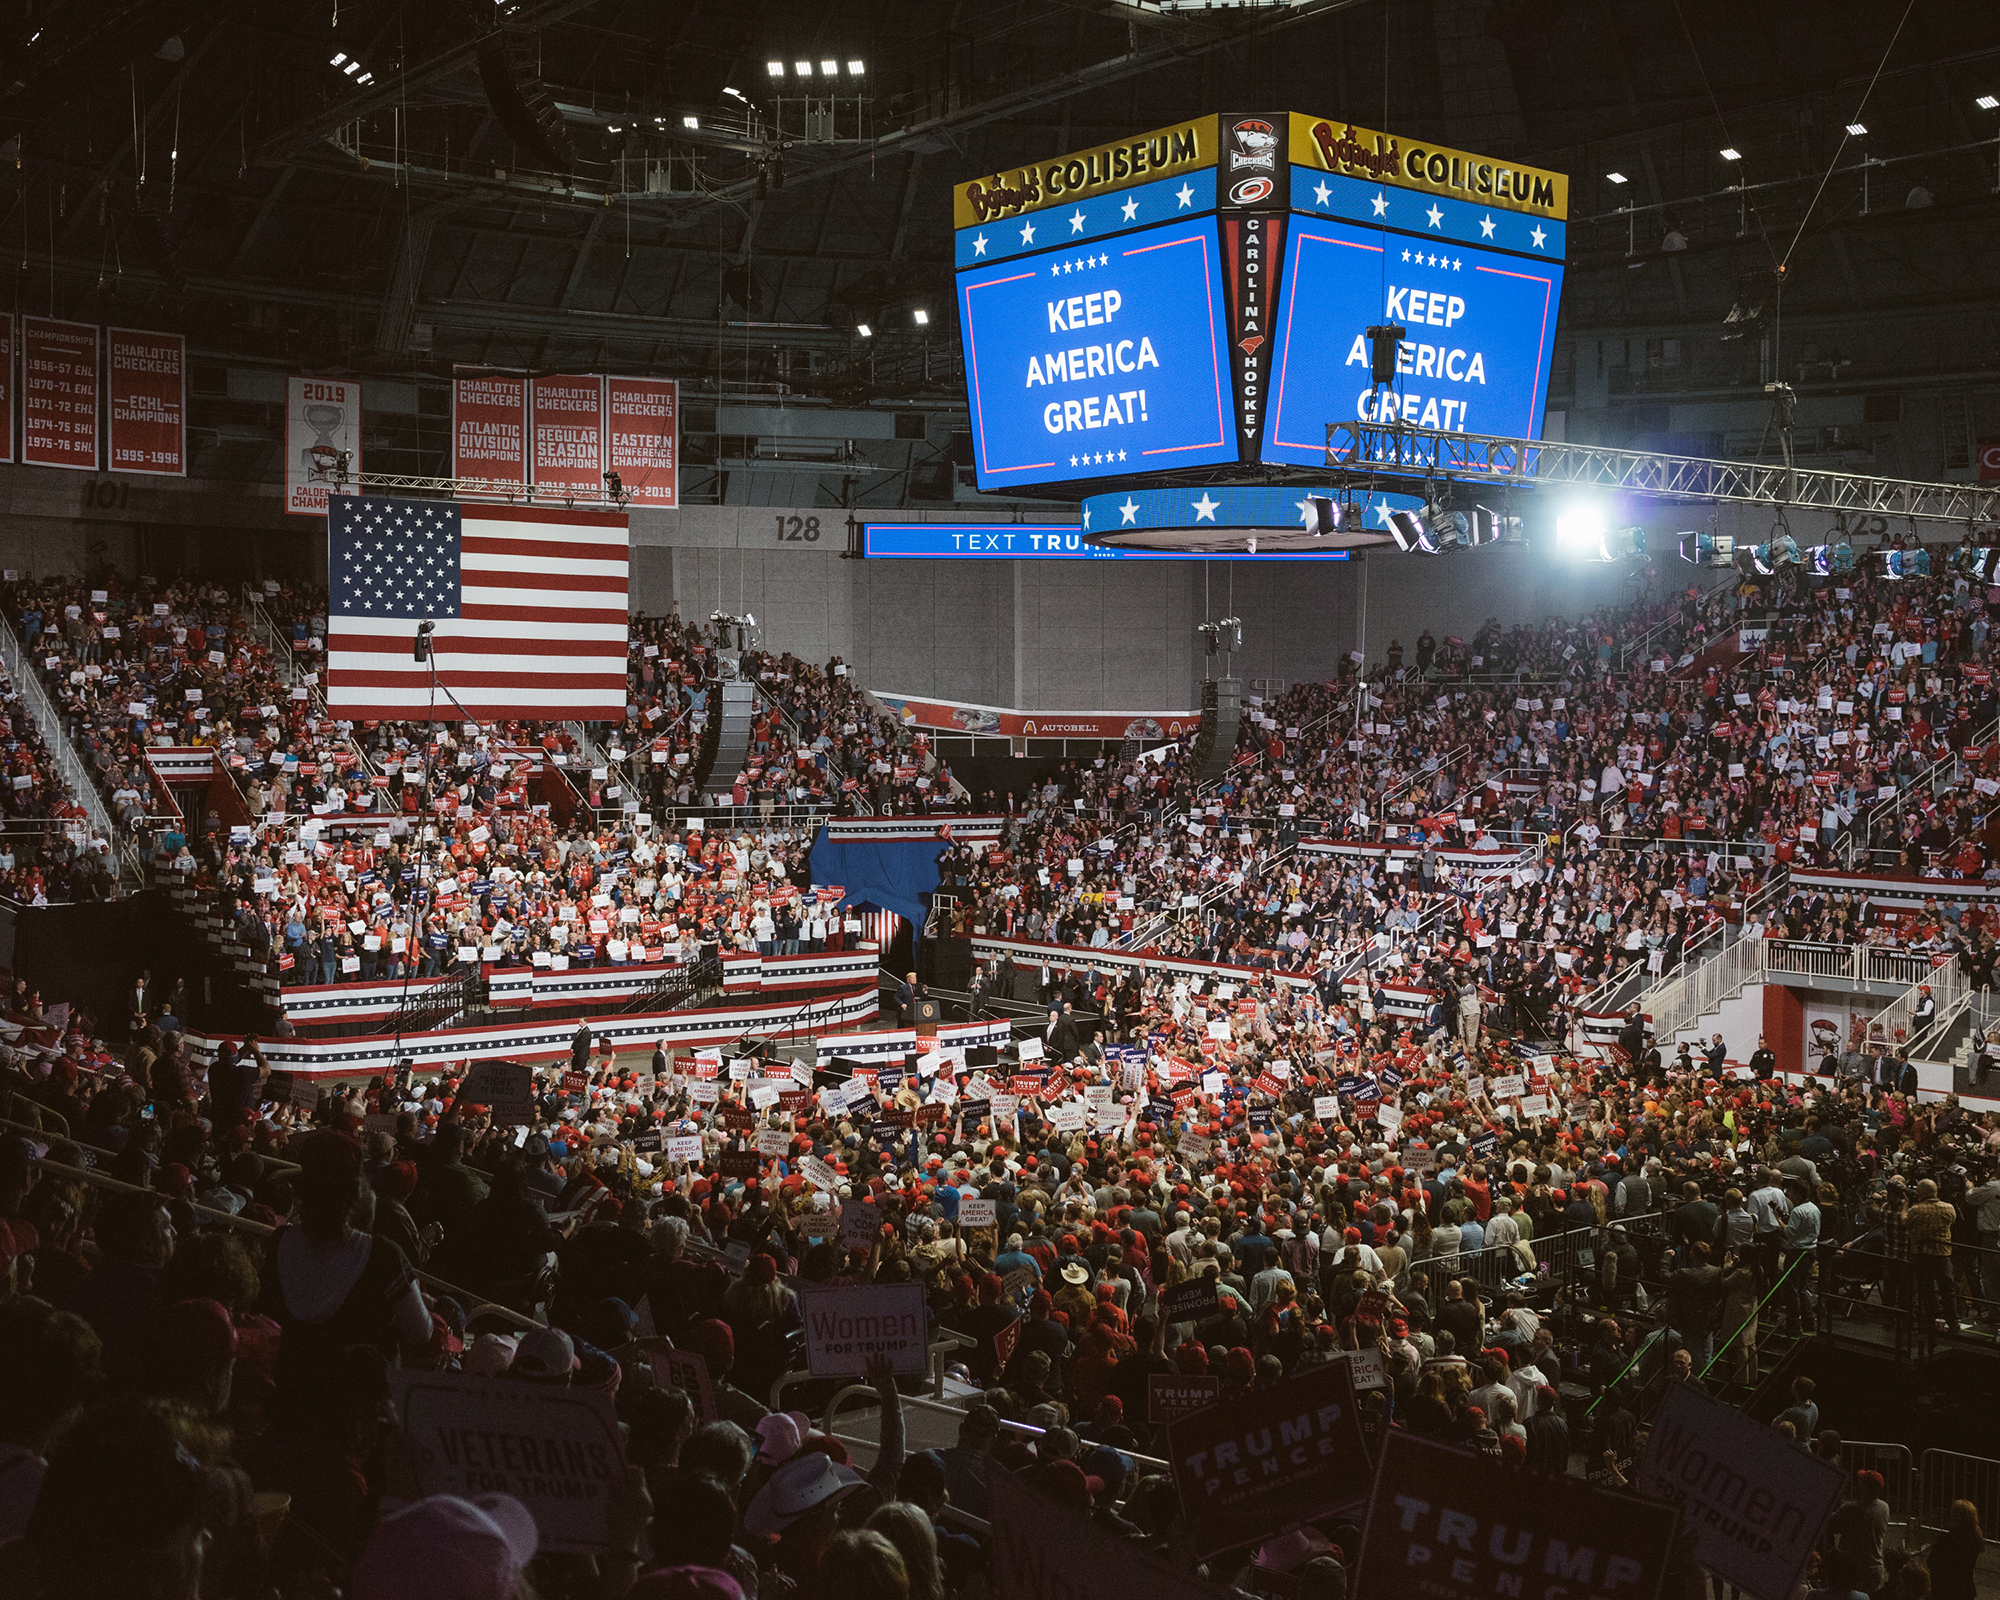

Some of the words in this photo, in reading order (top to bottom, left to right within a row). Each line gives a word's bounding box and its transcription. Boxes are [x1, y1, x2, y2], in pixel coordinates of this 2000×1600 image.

[1045, 128, 1196, 194] COLISEUM
[1407, 149, 1554, 207] COLISEUM
[1245, 219, 1260, 332] CAROLINA
[1047, 289, 1122, 333] KEEP
[1386, 285, 1465, 327] KEEP
[29, 329, 94, 346] CHAMPIONSHIPS
[114, 343, 179, 361] CHARLOTTE
[1345, 334, 1486, 385] AERICA
[29, 359, 71, 374] 1956-57
[75, 365, 94, 377] EHL
[114, 357, 180, 375] CHECKERS
[1026, 336, 1160, 388] AMERICA
[29, 378, 71, 393] 1970-71
[75, 384, 94, 395] EHL
[304, 383, 345, 402] 2019
[460, 380, 520, 395] CHARLOTTE
[537, 387, 597, 399] CHARLOTTE
[28, 397, 71, 412] 1971-72
[75, 404, 94, 415] EHL
[130, 395, 164, 411] ECHL
[460, 391, 520, 407] CHECKERS
[537, 398, 597, 412] CHECKERS
[613, 391, 672, 405] CHARLOTTE
[1244, 357, 1258, 439] HOCKEY
[114, 408, 179, 424] CHAMPIONS
[613, 402, 672, 417] CHECKERS
[1044, 389, 1148, 434] GREAT!
[1357, 389, 1467, 432] GREAT!
[28, 417, 71, 432] 1974-75
[74, 423, 93, 434] SHL
[460, 421, 520, 437] ATLANTIC
[460, 434, 520, 450] DIVISION
[538, 428, 597, 443] REGULAR
[613, 433, 672, 448] EASTERN
[27, 436, 71, 450] 1975-76
[74, 441, 93, 453] SHL
[538, 442, 597, 458] SEASON
[613, 446, 672, 458] CONFERENCE
[115, 449, 179, 464] 1995-1996
[460, 448, 520, 462] CHAMPIONS
[538, 457, 598, 469] CHAMPIONS
[613, 456, 672, 468] CHAMPIONS
[82, 479, 130, 510] 101
[296, 487, 329, 497] CALDER
[775, 515, 820, 542] 128
[952, 534, 1013, 551] TEXT
[1041, 724, 1099, 732] AUTOBELL
[1517, 1042, 1539, 1055] PROMISES
[1611, 1046, 1626, 1059] TRUMP
[1171, 1060, 1192, 1071] TRUMP
[978, 1082, 989, 1091] KEEP
[1043, 1077, 1062, 1094] TRUMP
[1261, 1075, 1282, 1089] TRUMP
[1173, 1094, 1192, 1102] TRUMP
[1354, 1084, 1376, 1097] PROMISES
[850, 1099, 875, 1112] PROMISES
[962, 1104, 989, 1112] PROMISES
[1152, 1101, 1174, 1111] PROMISES
[1524, 1100, 1544, 1108] Women
[1100, 1109, 1124, 1117] Women
[1181, 1140, 1205, 1151] AMERICA
[1188, 1136, 1202, 1144] KEEP
[1473, 1138, 1495, 1149] PROMISES
[1480, 1144, 1493, 1152] MADE
[808, 1165, 833, 1183] AMERICA
[817, 1161, 829, 1172] KEEP
[1177, 1288, 1202, 1300] KEPT
[812, 1310, 917, 1341] Women
[825, 1343, 851, 1353] FOR
[857, 1340, 907, 1352] TRUMP
[1155, 1389, 1213, 1398] TRUMP
[1186, 1404, 1341, 1478] TRUMP
[439, 1427, 610, 1479] VETERANS
[1206, 1438, 1335, 1496] PENCE
[466, 1471, 508, 1491] FOR
[519, 1477, 600, 1498] TRUMP
[1655, 1414, 1807, 1544] Women
[1654, 1475, 1687, 1501] FOR
[1690, 1500, 1772, 1554] TRUMP
[1394, 1494, 1643, 1590] TRUMP
[1406, 1544, 1608, 1600] PENC
